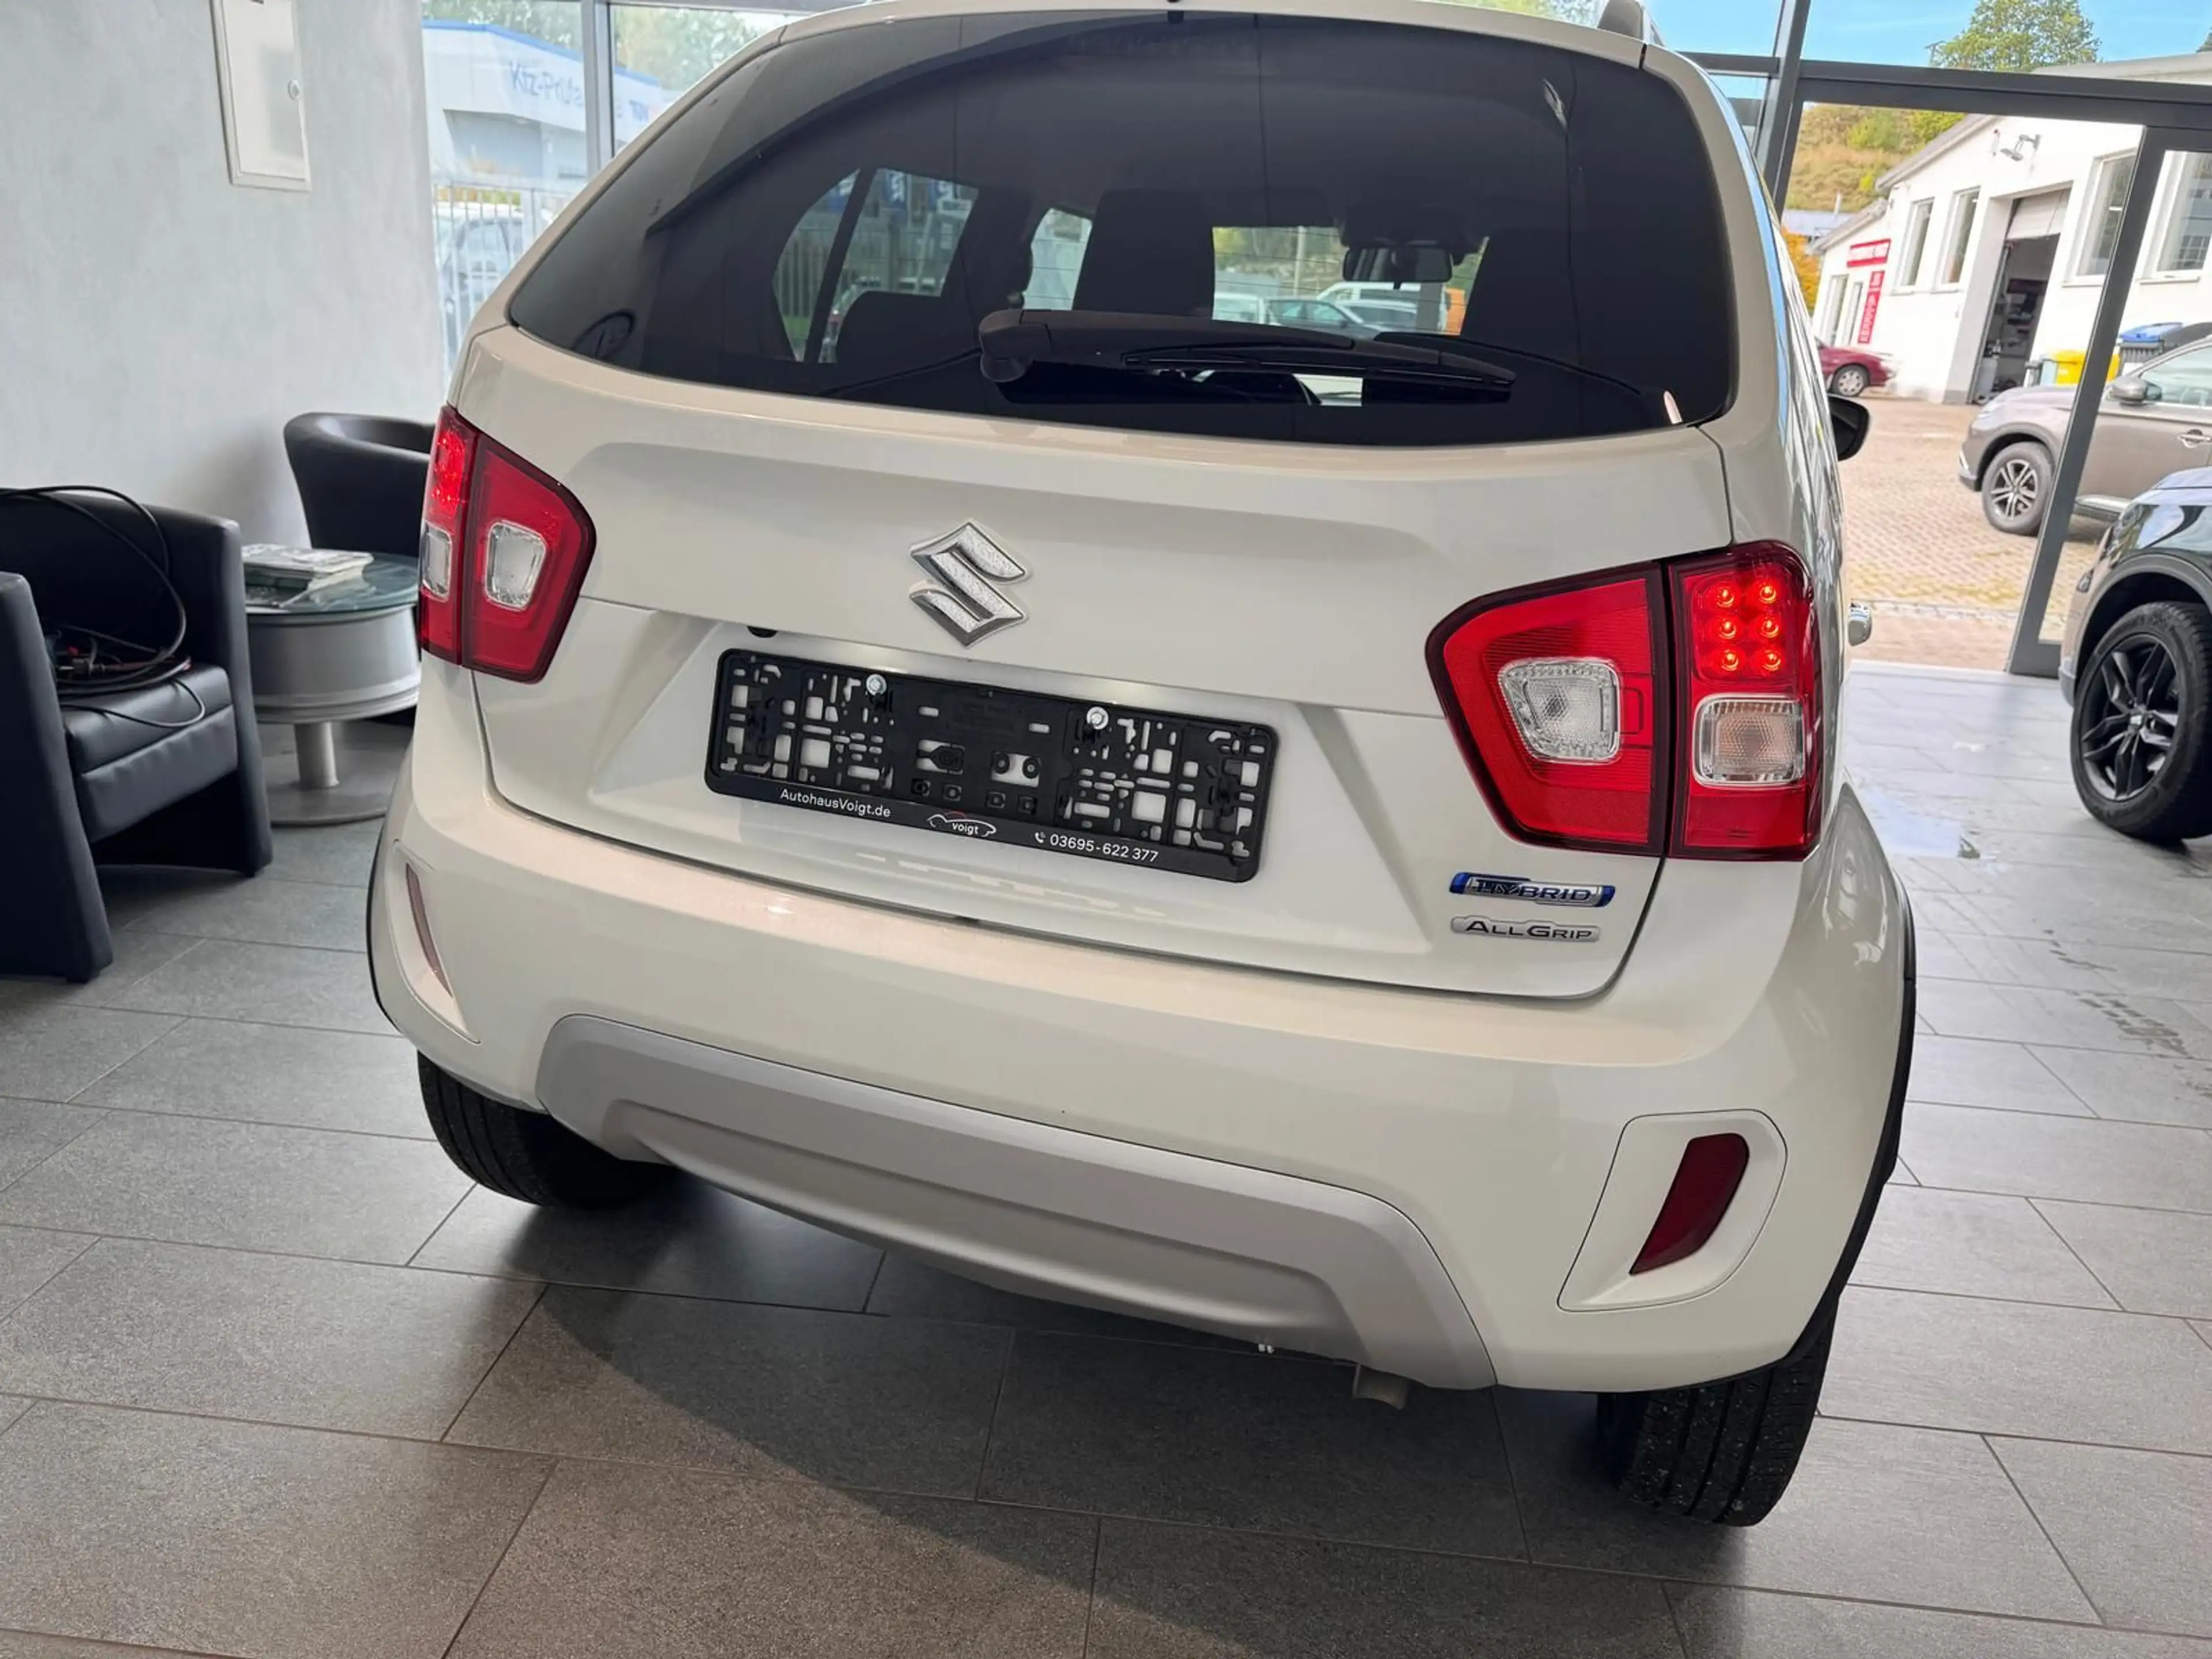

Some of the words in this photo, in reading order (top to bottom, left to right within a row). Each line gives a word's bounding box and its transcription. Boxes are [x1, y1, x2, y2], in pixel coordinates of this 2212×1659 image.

[780, 788, 891, 817] AutohausVoigt.de
[952, 822, 979, 836] voigt
[1132, 847, 1159, 862] 377
[1476, 879, 1592, 902] HYBRID
